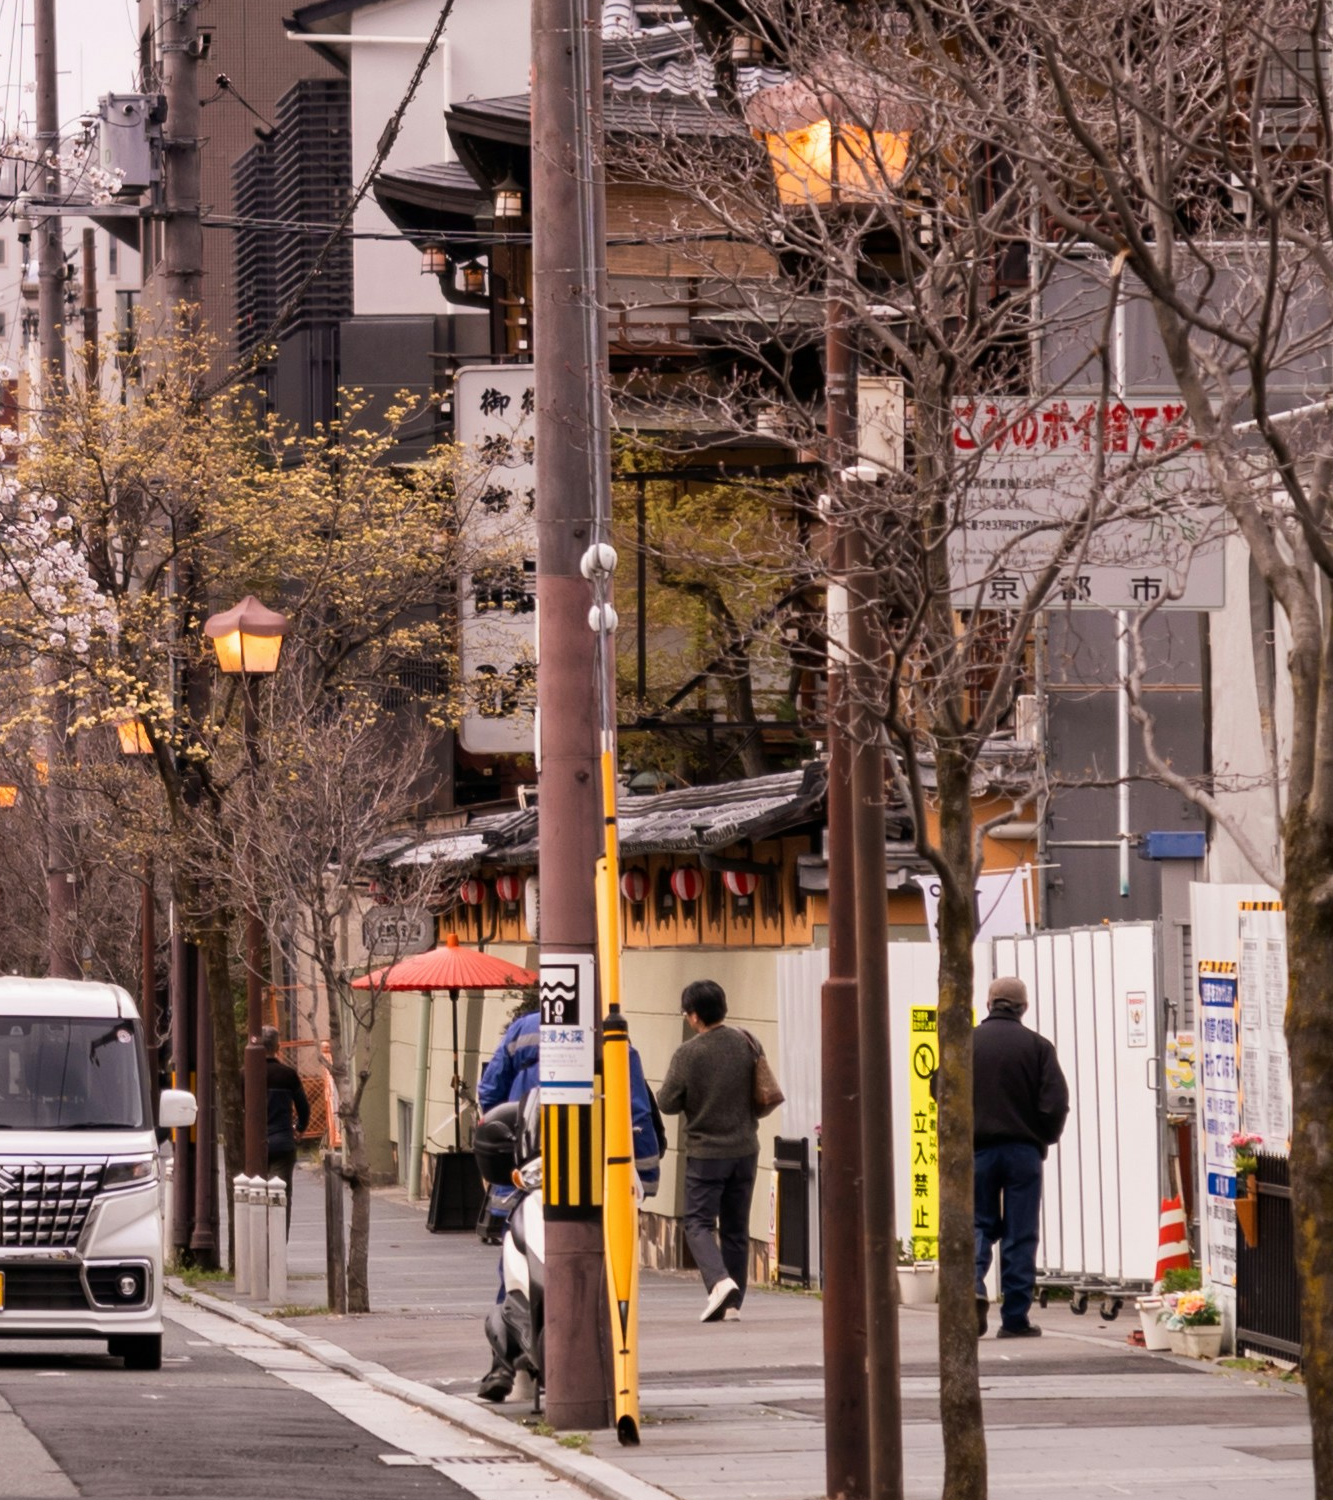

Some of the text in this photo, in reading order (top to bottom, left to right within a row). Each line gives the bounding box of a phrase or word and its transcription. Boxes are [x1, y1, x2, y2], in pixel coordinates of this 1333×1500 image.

[953, 400, 1203, 452] ごみのポイ捨て禁
[989, 575, 1163, 602] 京都市
[913, 1110, 929, 1230] 立入禁止
